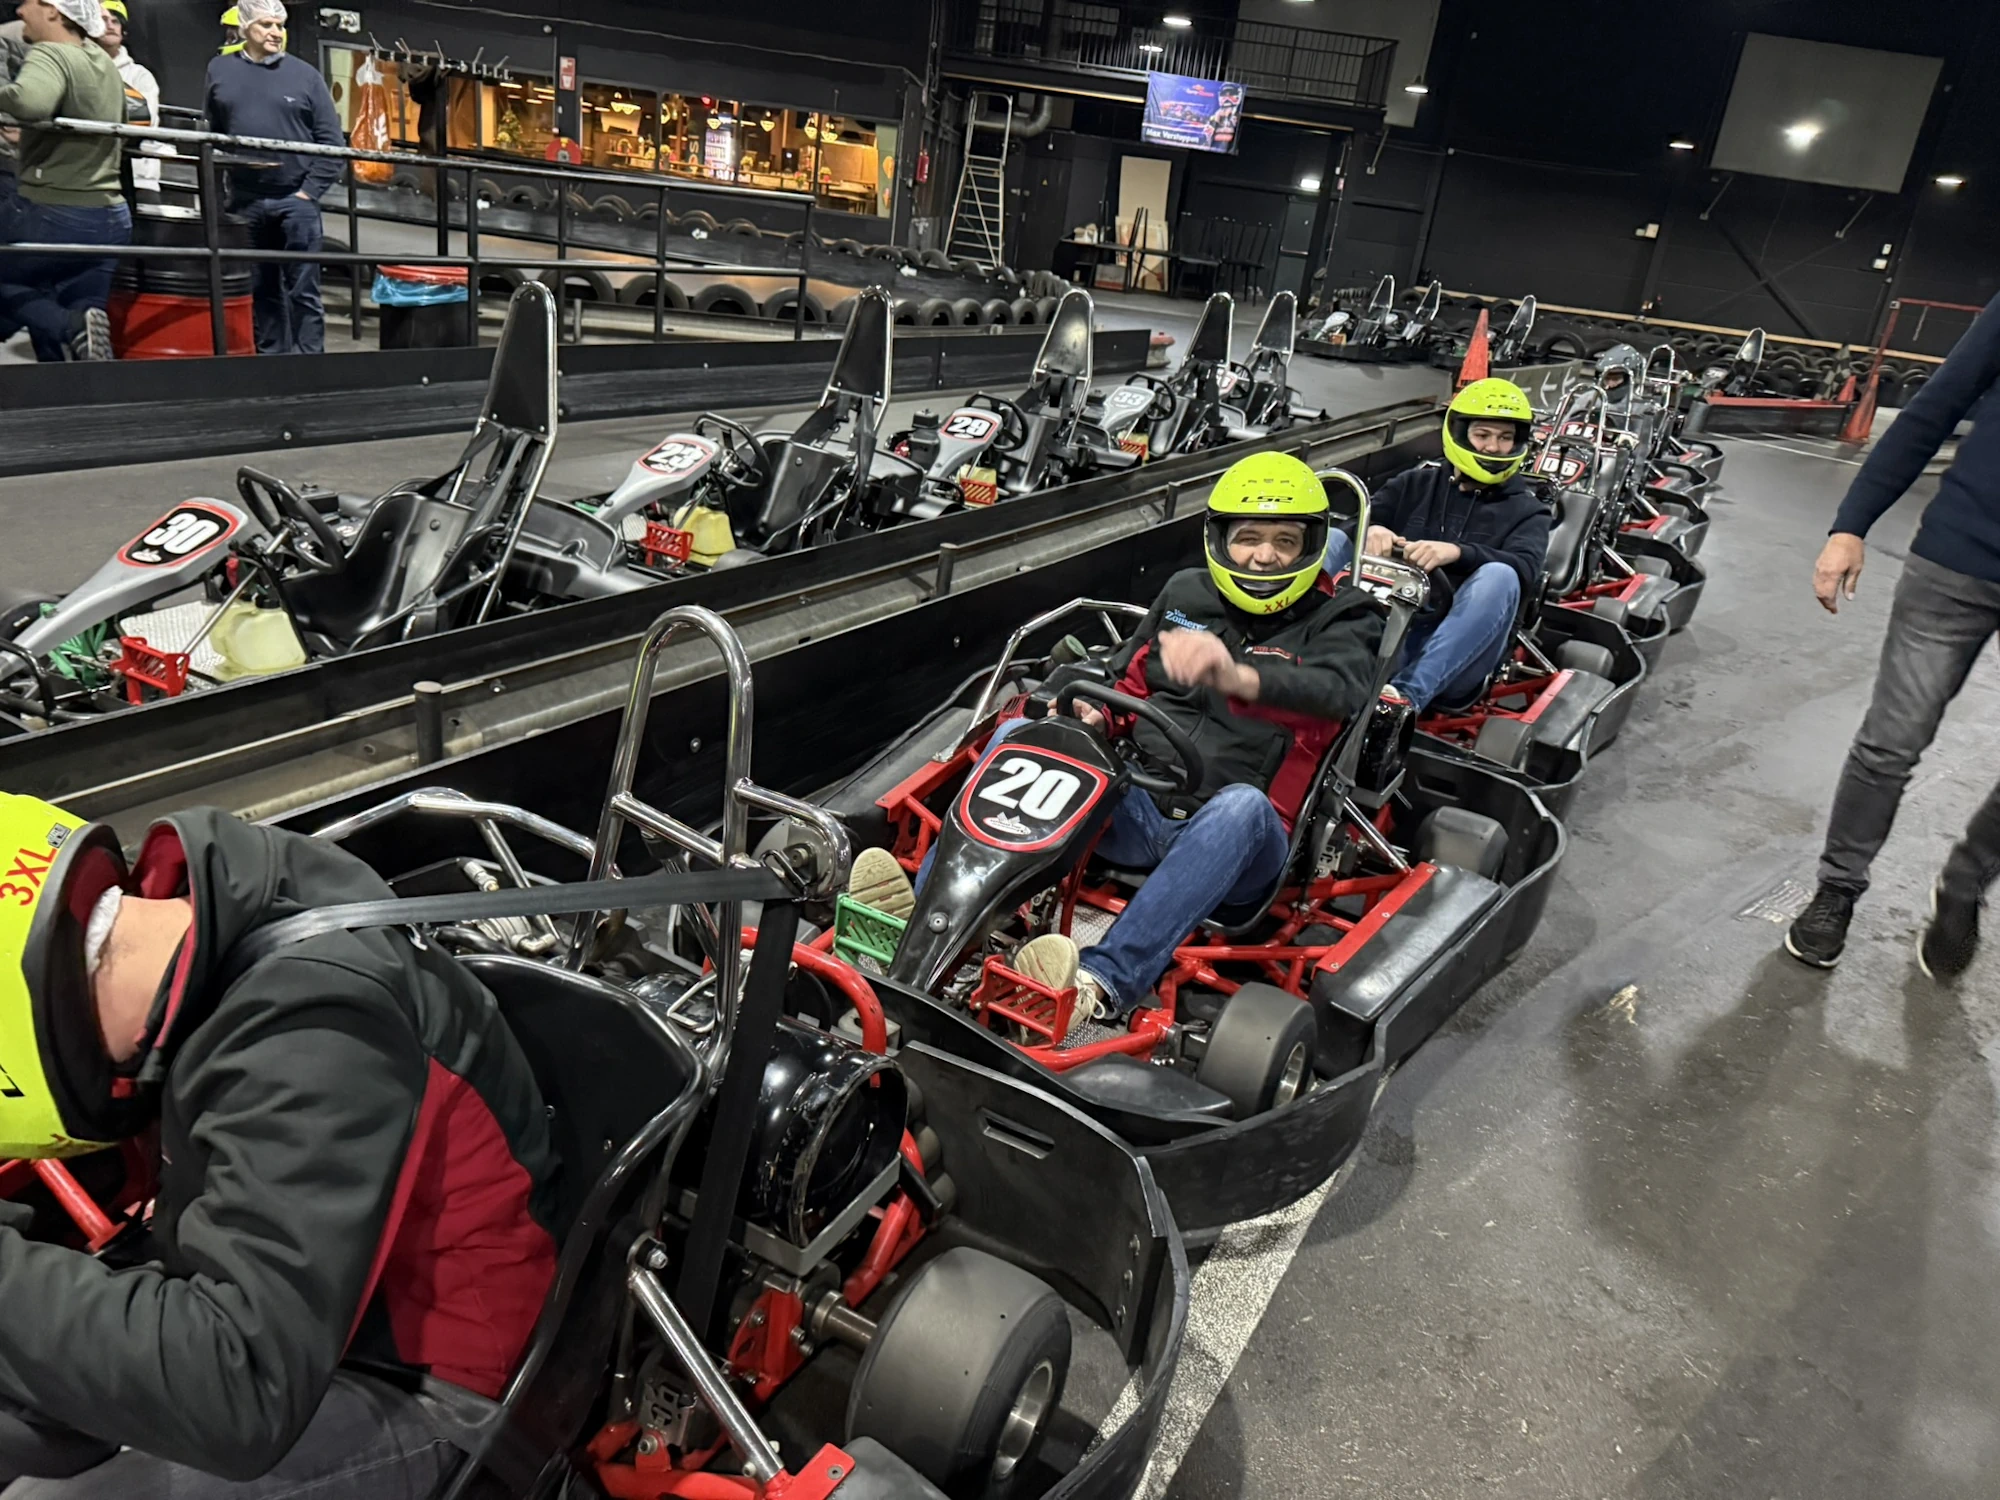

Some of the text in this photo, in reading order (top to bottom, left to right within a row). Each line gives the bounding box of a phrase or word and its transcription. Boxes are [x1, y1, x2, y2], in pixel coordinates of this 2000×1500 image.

[1114, 391, 1145, 405] 33
[1241, 495, 1293, 504] LS2
[143, 513, 220, 554] 30
[1264, 596, 1292, 613] XXL
[978, 757, 1081, 820] 20
[0, 848, 57, 906] 3XL
